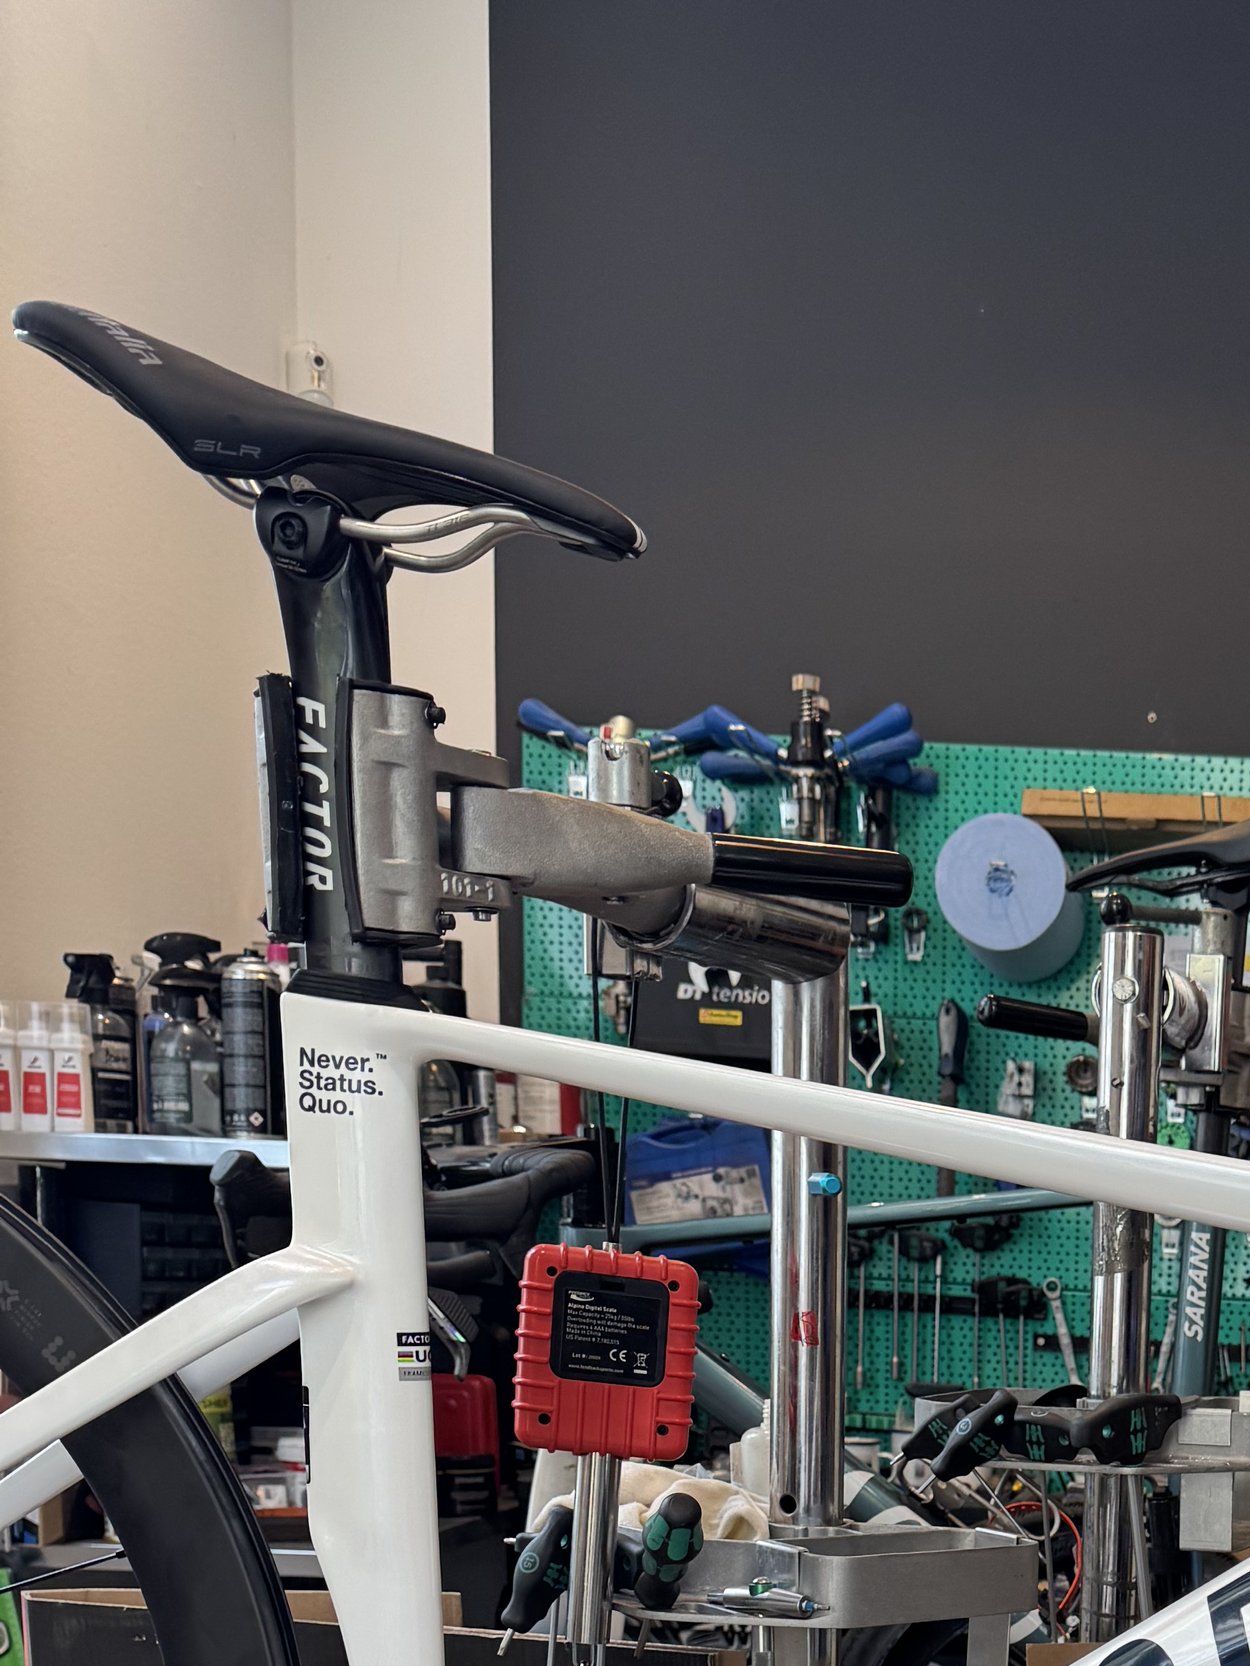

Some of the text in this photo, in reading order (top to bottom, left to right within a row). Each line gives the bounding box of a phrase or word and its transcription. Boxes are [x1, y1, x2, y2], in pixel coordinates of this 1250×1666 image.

[193, 439, 261, 459] SLR
[296, 697, 334, 891] FACTOR
[299, 1069, 383, 1096] Status.
[299, 1092, 354, 1116] Quo.
[1183, 1231, 1211, 1342] SARANA
[579, 1310, 600, 1319] Capacity
[585, 1304, 602, 1312] Digital
[567, 1316, 597, 1325] Overloading
[607, 1320, 627, 1328] damage
[609, 1348, 628, 1362] CE
